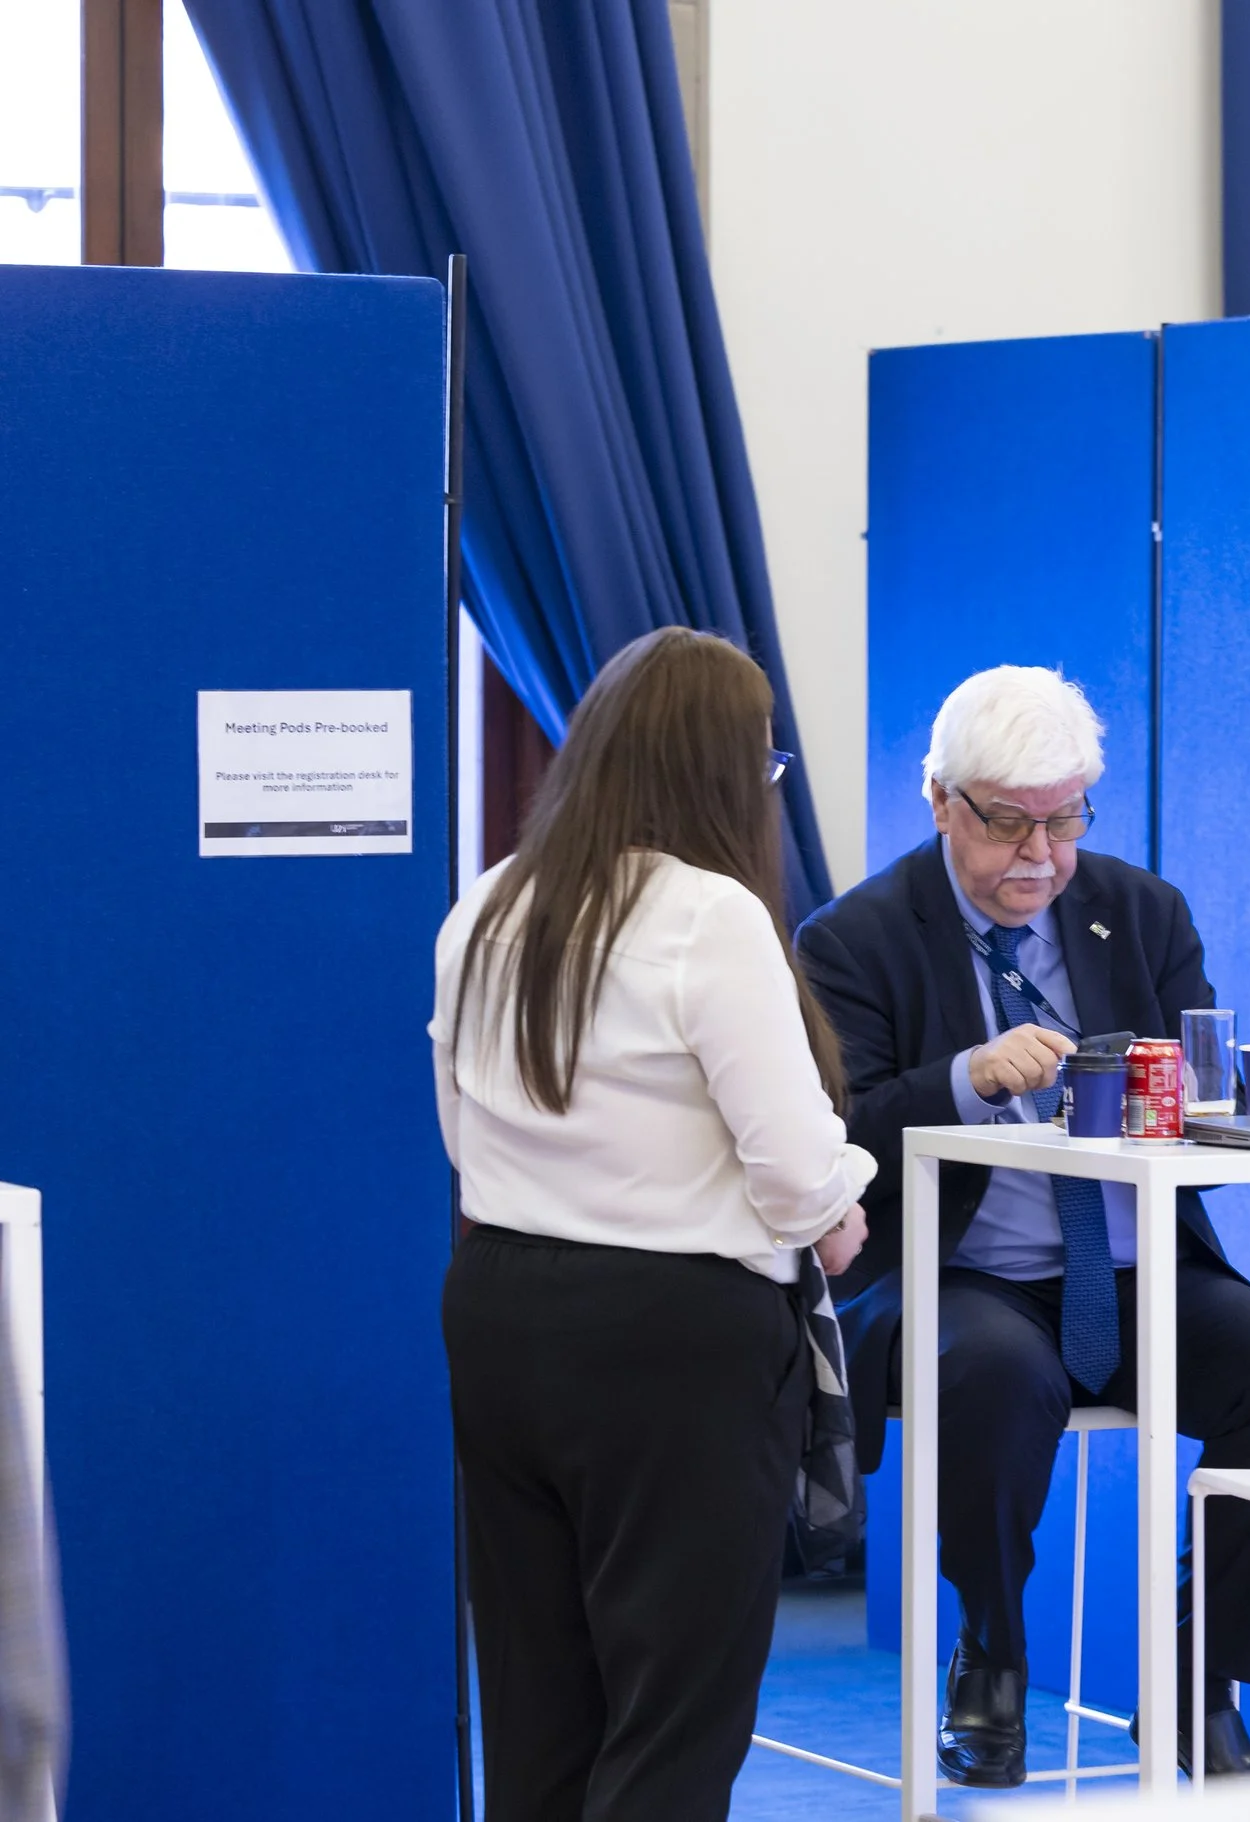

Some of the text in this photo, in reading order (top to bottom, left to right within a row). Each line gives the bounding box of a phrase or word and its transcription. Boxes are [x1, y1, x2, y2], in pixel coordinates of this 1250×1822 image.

[225, 721, 388, 735] Meeting Pods Pre-booked
[215, 770, 400, 782] Please visit the registration desk for
[262, 782, 354, 792] more information
